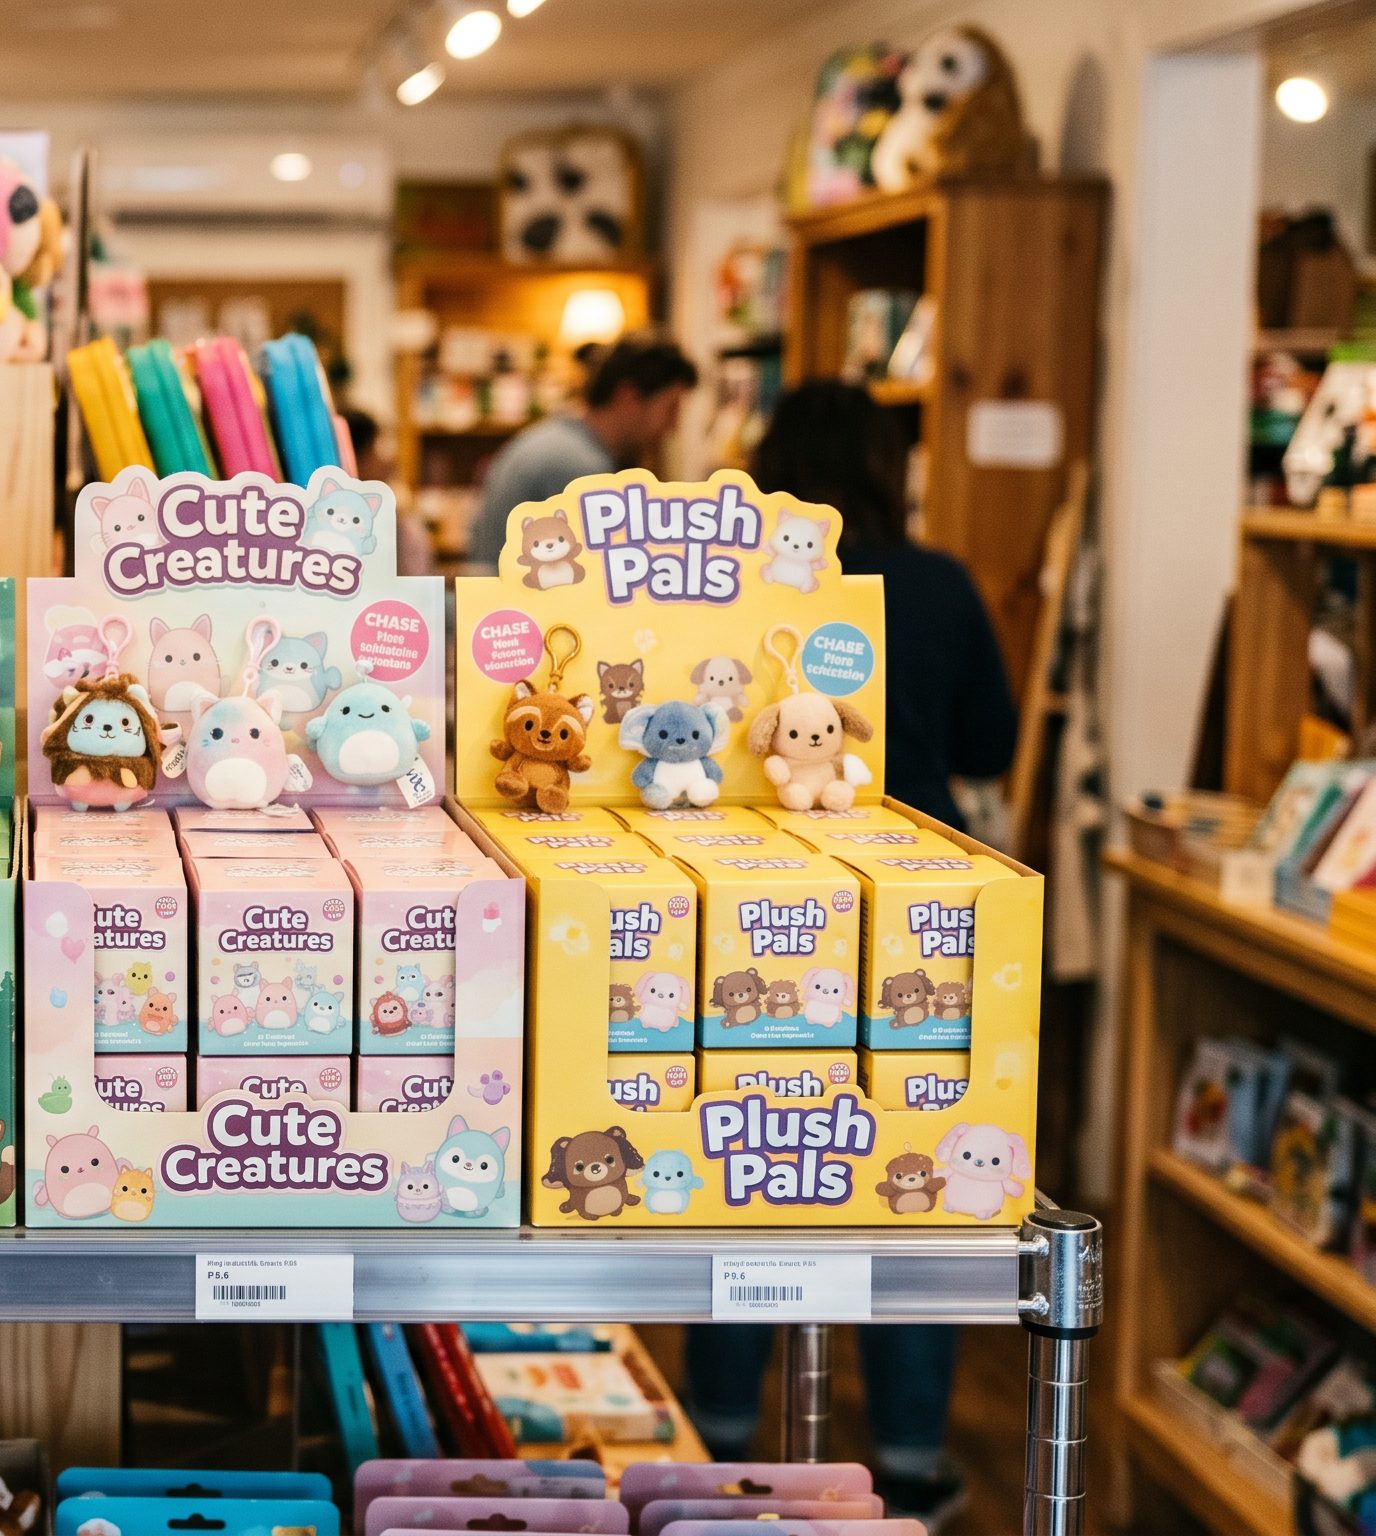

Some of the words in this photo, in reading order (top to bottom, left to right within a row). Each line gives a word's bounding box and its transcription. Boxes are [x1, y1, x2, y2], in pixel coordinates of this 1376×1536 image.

[162, 488, 300, 539] Cute
[584, 488, 757, 547] Plush
[108, 538, 360, 592] Creatures
[608, 543, 736, 599] Pals
[365, 612, 420, 633] CHASE
[480, 621, 530, 639] CHASE
[813, 635, 865, 655] CHASE
[96, 907, 140, 928] ute
[245, 907, 306, 929] Cute
[408, 907, 455, 929] Cut
[610, 904, 660, 932] ush
[740, 899, 825, 929] Plush
[910, 902, 974, 931] Plus
[94, 929, 164, 949] atures
[221, 930, 332, 951] Creatures
[384, 931, 456, 951] Creatu
[610, 931, 649, 958] als
[752, 926, 815, 954] Pals
[98, 1077, 140, 1098] ute
[244, 1076, 305, 1098] Cute
[406, 1077, 452, 1098] Cut
[609, 1074, 658, 1101] ush
[908, 1075, 968, 1103] Plus
[212, 1104, 337, 1147] Cute
[705, 1098, 871, 1153] Plush
[165, 1150, 388, 1185] Creatures
[730, 1149, 847, 1200] Pals
